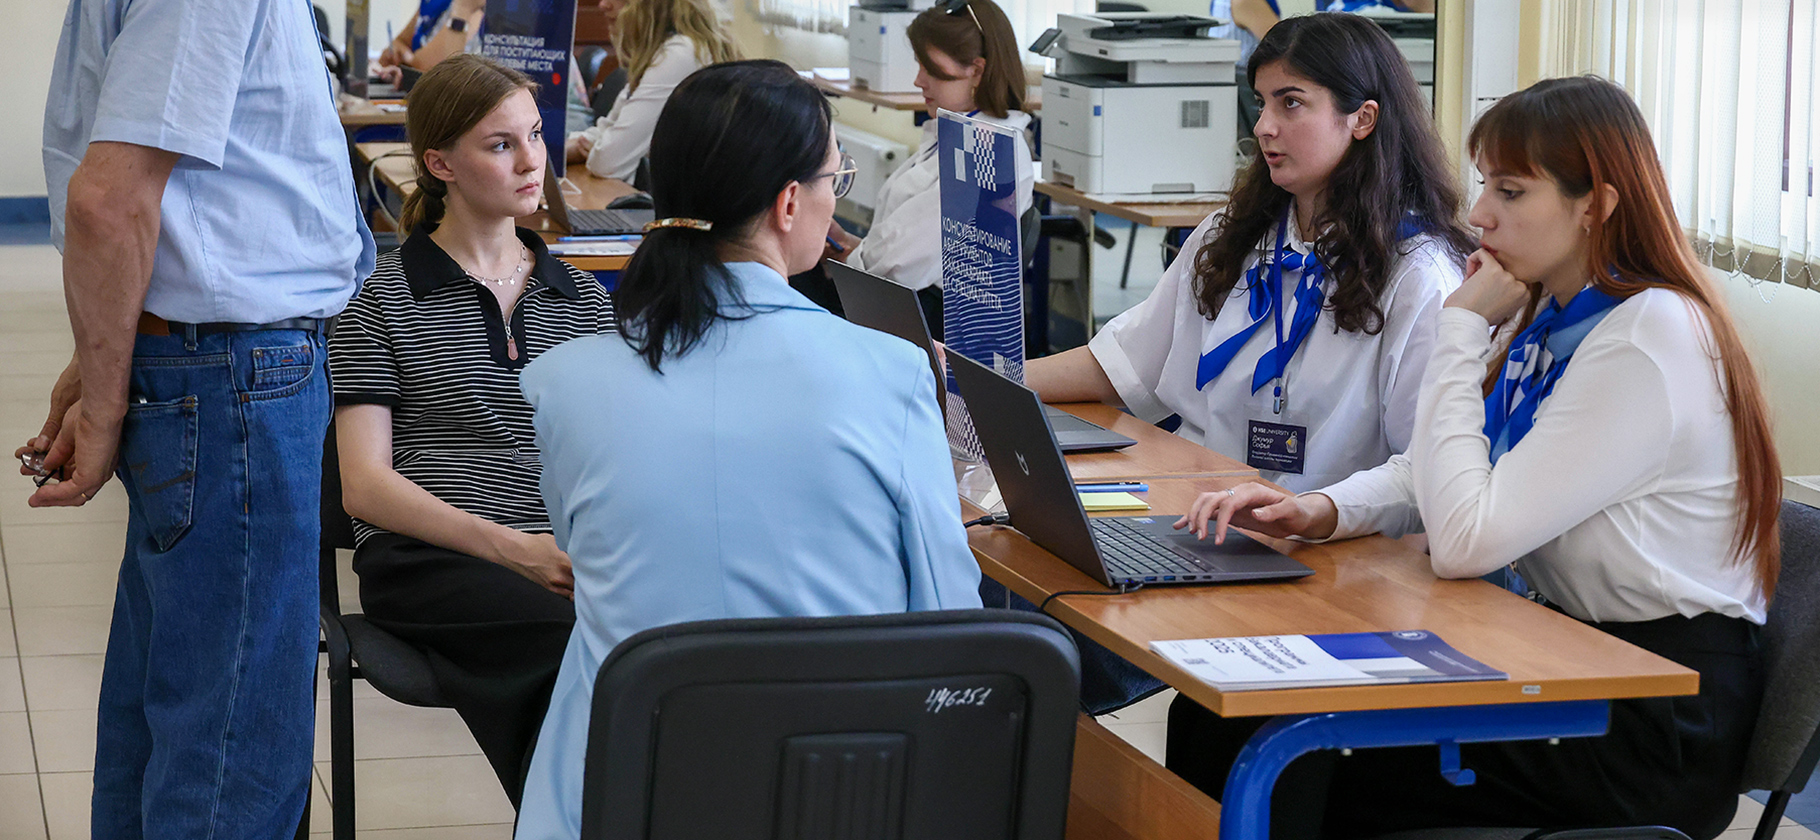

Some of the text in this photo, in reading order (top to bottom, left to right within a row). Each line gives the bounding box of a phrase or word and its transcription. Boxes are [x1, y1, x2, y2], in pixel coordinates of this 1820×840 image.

[484, 34, 544, 47] КОНСУЛЬТАЦИЯ
[500, 46, 566, 61] ПОСТУПАЮЩИХ
[527, 61, 553, 71] МЕСТА
[942, 216, 1012, 256] КОНСУЛЬТИРОВАНИЕ
[943, 236, 993, 267] АБИТУРИЕНТОВ
[925, 687, 992, 713] 446251
